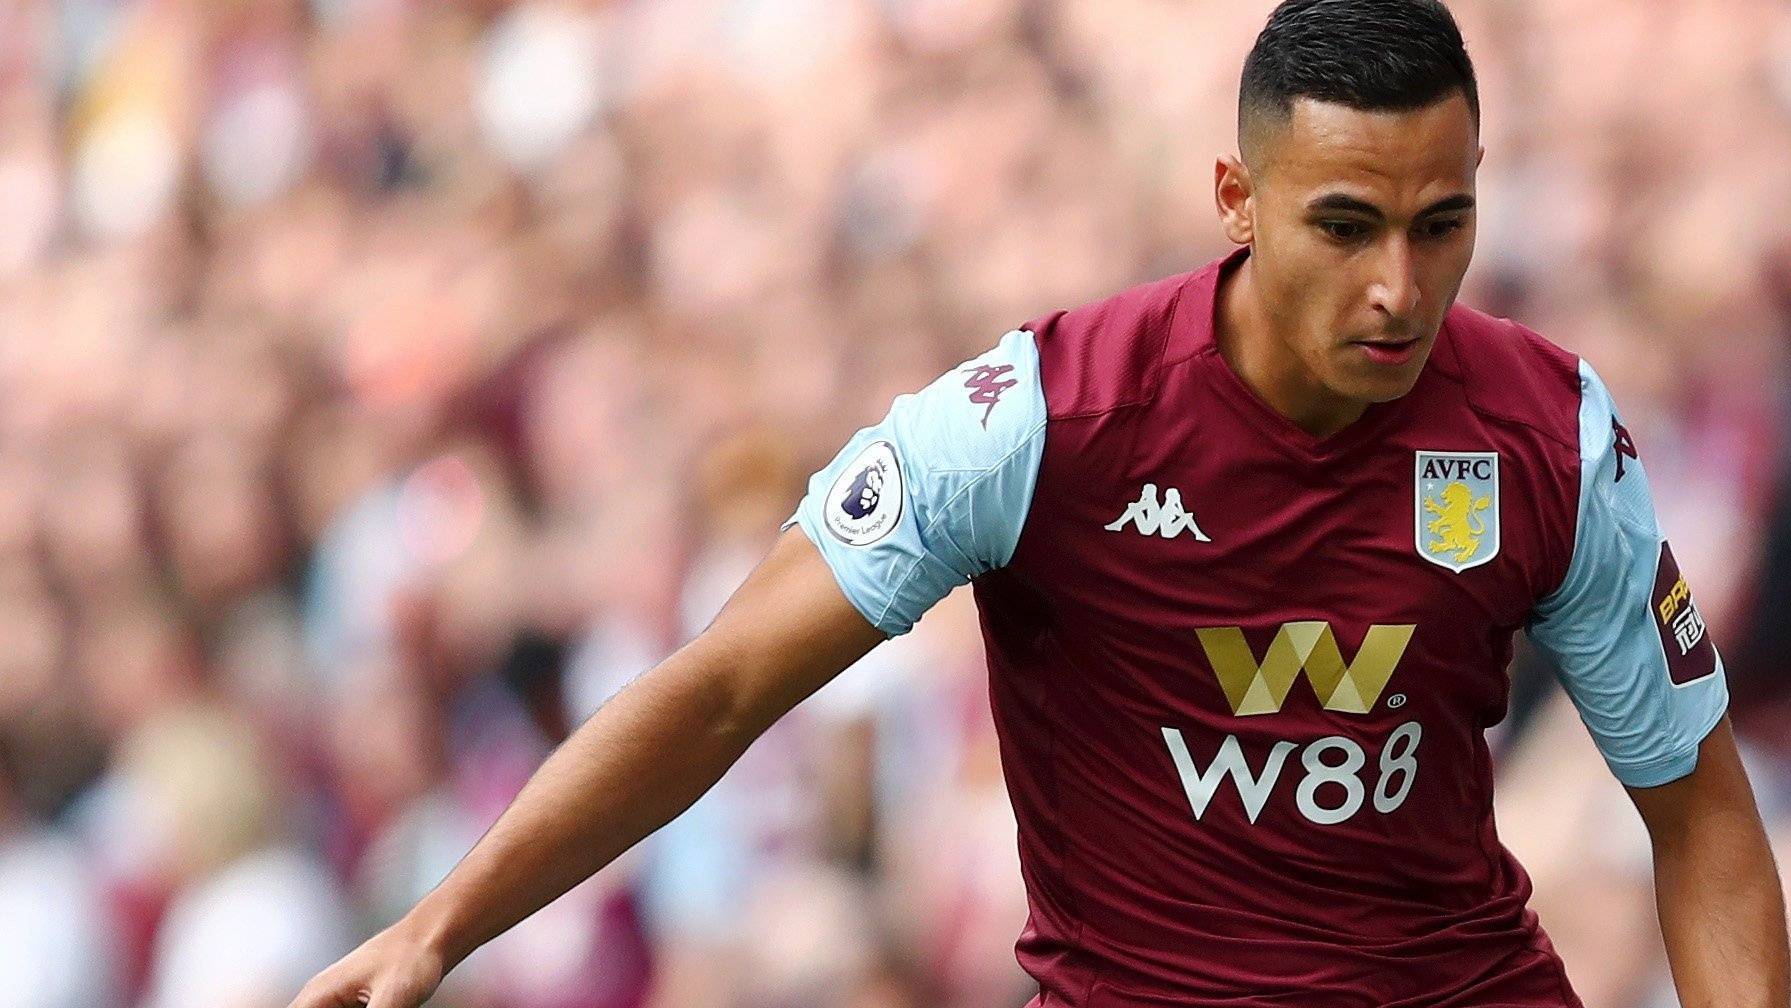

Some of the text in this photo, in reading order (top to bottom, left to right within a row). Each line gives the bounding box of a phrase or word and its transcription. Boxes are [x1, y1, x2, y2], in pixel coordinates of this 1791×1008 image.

[1422, 459, 1491, 480] AVFC
[834, 513, 887, 535] Premier League
[1161, 721, 1422, 825] W88
